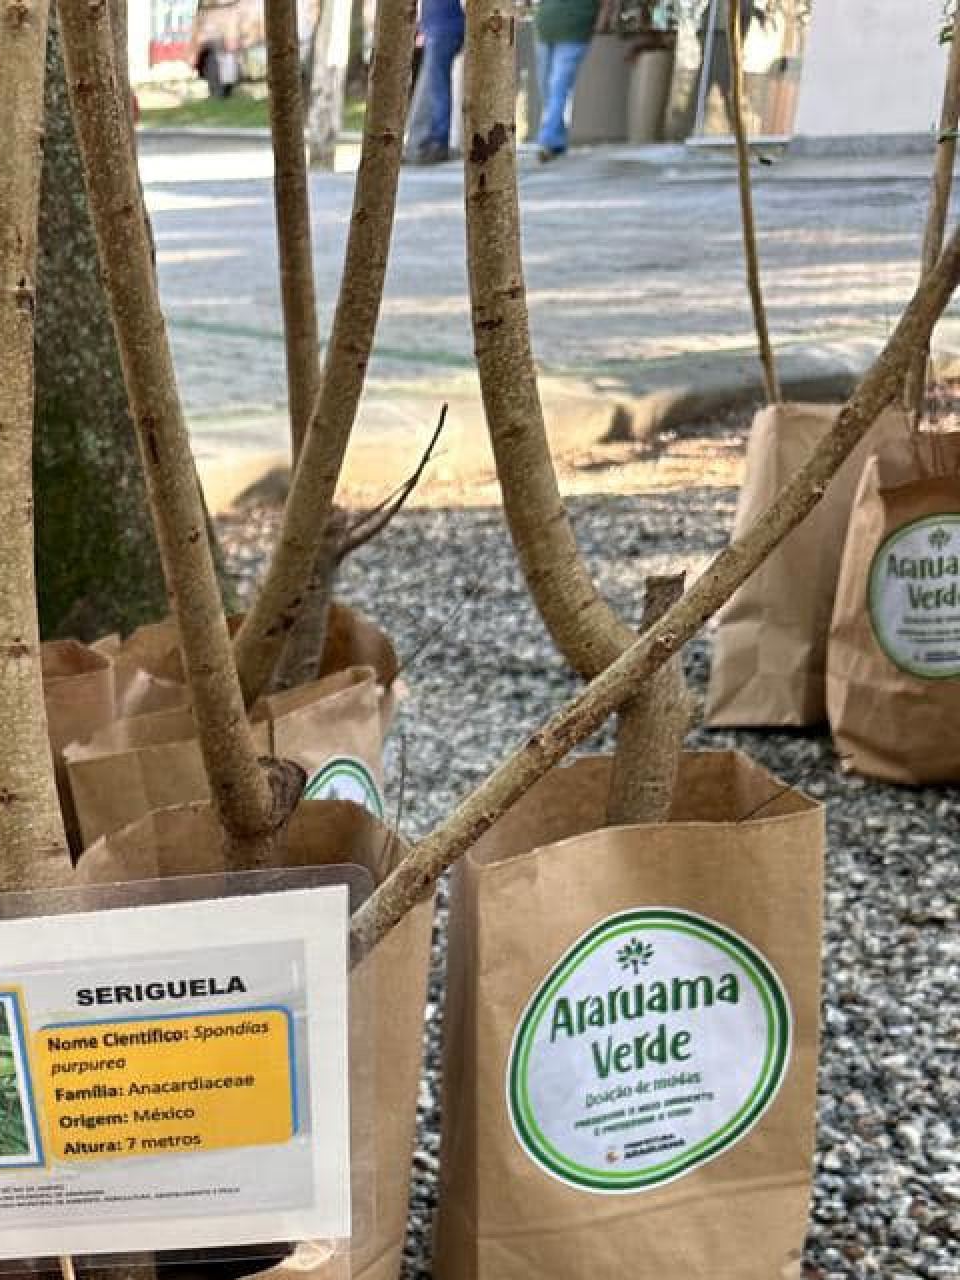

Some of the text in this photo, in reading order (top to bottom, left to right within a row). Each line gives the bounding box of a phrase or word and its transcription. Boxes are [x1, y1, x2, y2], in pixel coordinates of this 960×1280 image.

[908, 582, 960, 610] Verd
[76, 976, 247, 1006] SERIGUELA
[550, 972, 739, 1043] Araruama
[47, 1036, 98, 1052] Nome
[592, 1023, 692, 1079] Verde
[51, 1058, 126, 1076] purpurea
[55, 1075, 255, 1102] Família: Anacardiaceae
[59, 1107, 195, 1129] Origem: México
[64, 1134, 202, 1155] Altura: 7 metros
